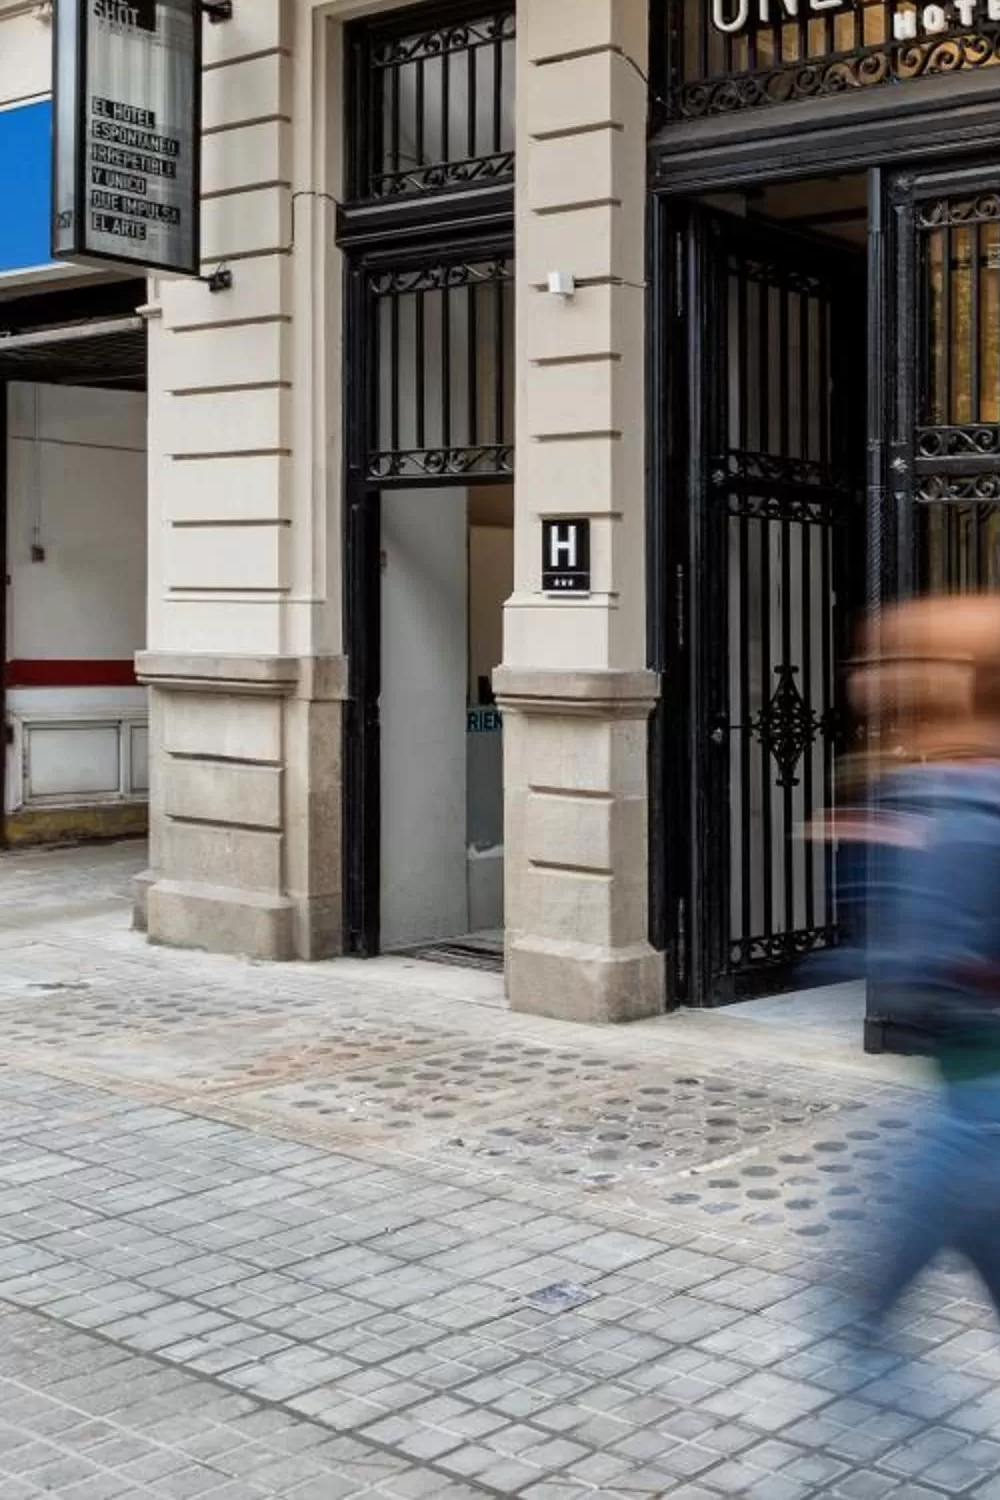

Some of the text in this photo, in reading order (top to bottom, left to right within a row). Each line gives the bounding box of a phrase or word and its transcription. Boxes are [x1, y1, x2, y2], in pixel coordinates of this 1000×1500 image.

[92, 0, 140, 27] SHOT
[93, 100, 153, 128] EL HOTEL
[93, 168, 103, 184] Y
[93, 191, 120, 210] QUE
[93, 213, 145, 240] EL ARTE
[550, 525, 577, 567] H
